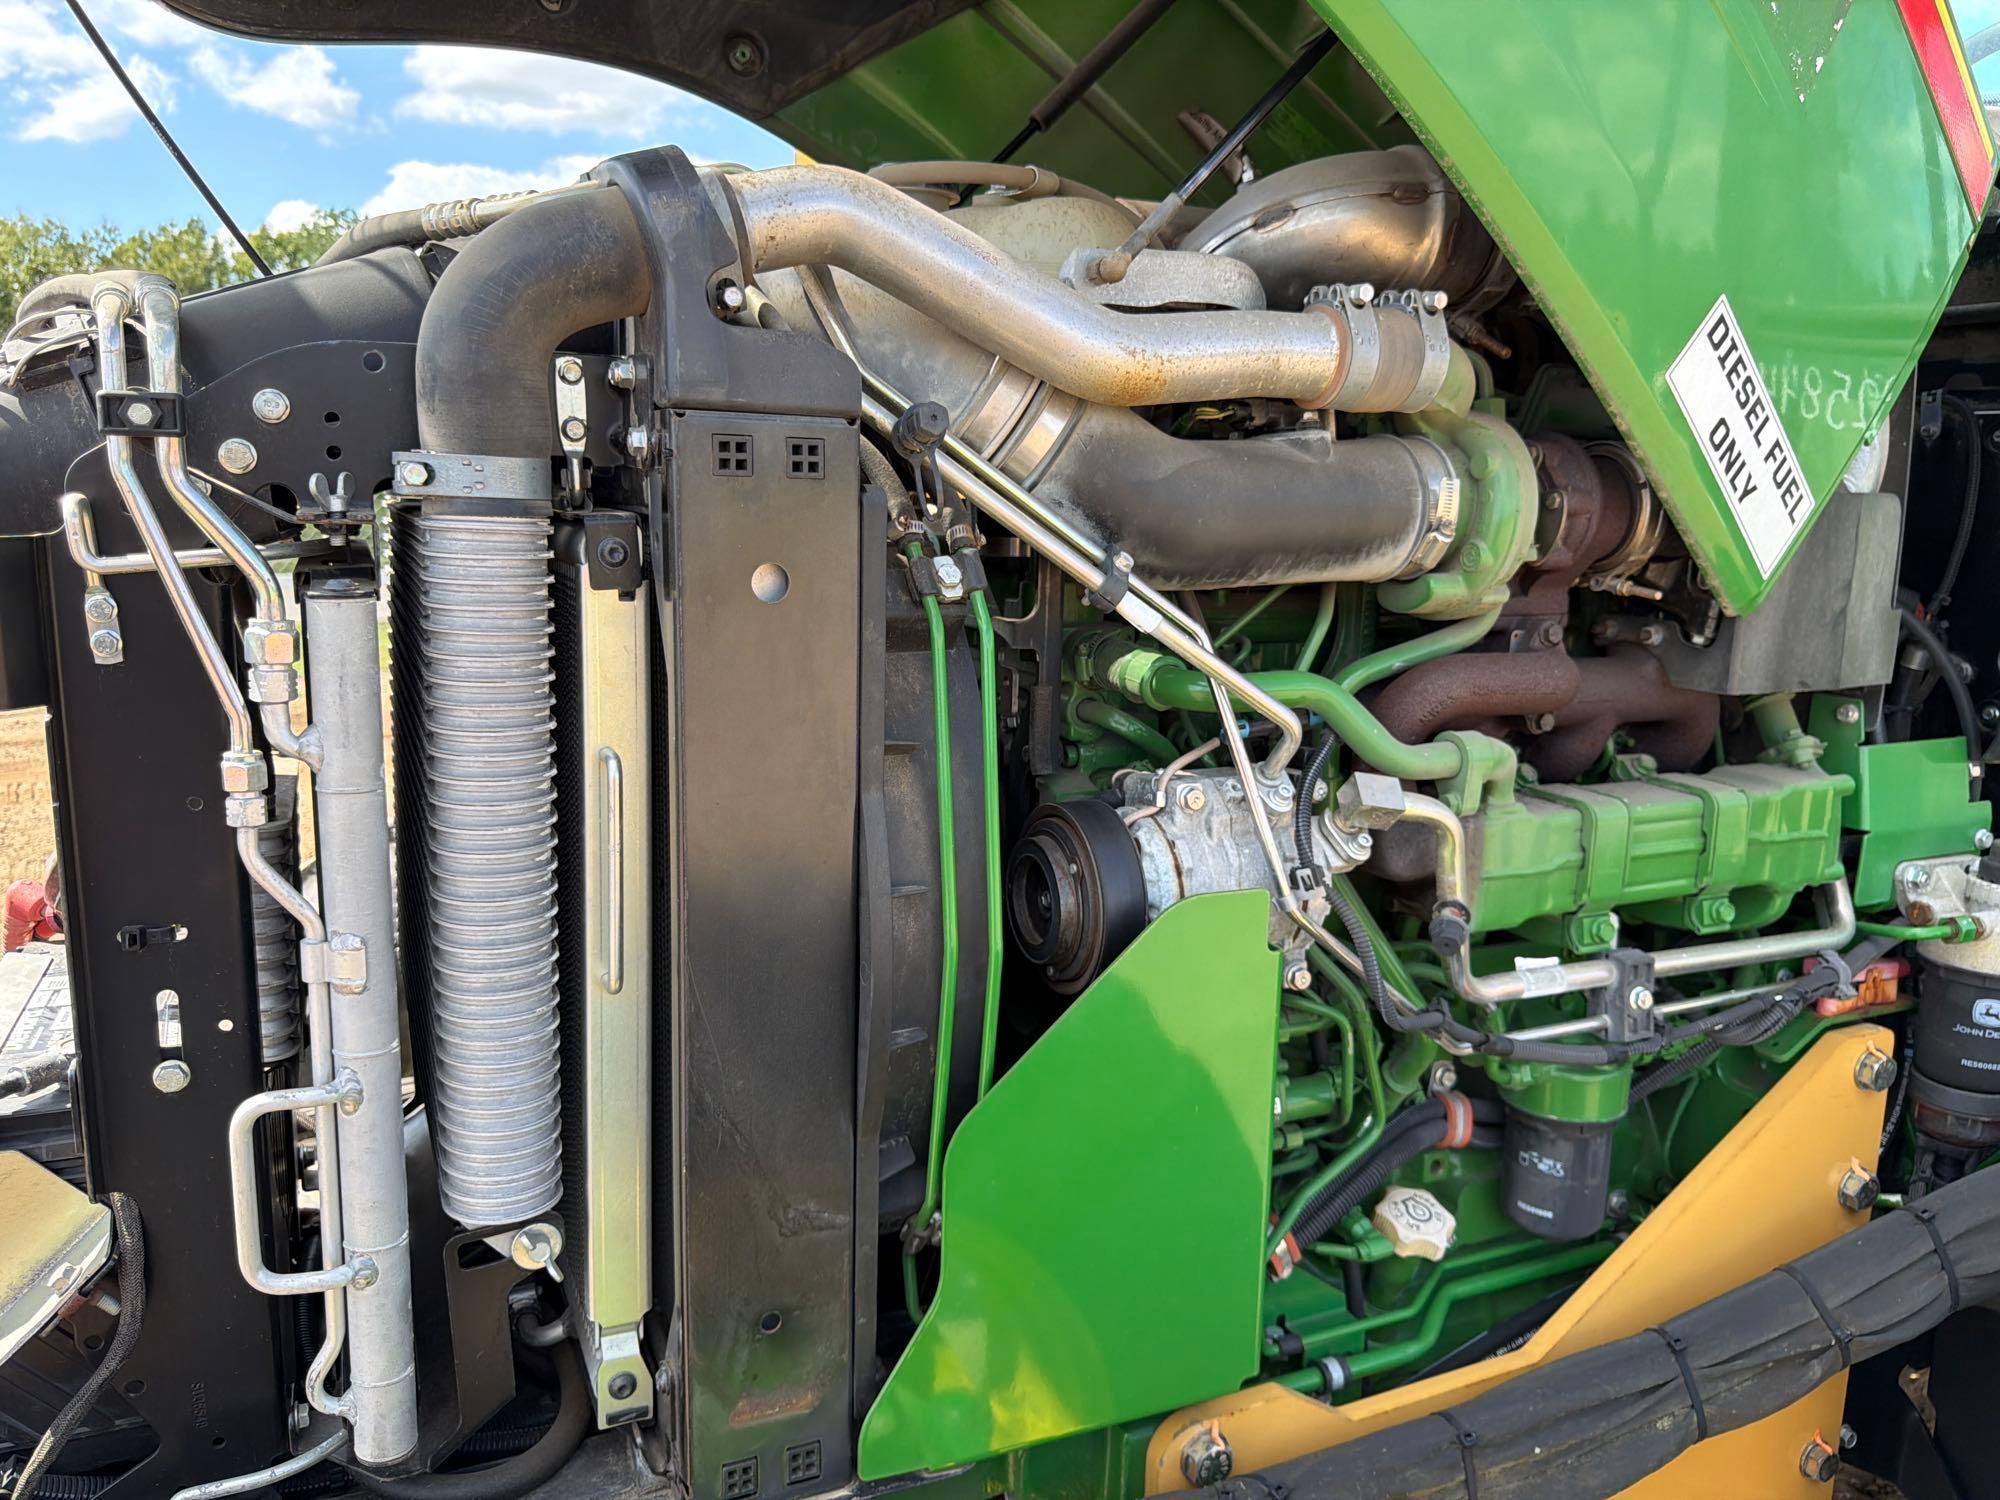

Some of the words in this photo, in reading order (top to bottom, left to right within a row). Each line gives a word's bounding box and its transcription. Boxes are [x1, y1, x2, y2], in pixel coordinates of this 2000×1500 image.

[1706, 313, 1771, 448] DIESEL
[1763, 438, 1805, 525] FUEL
[1708, 416, 1758, 505] ONLY
[1952, 1023, 1984, 1037] JOHN
